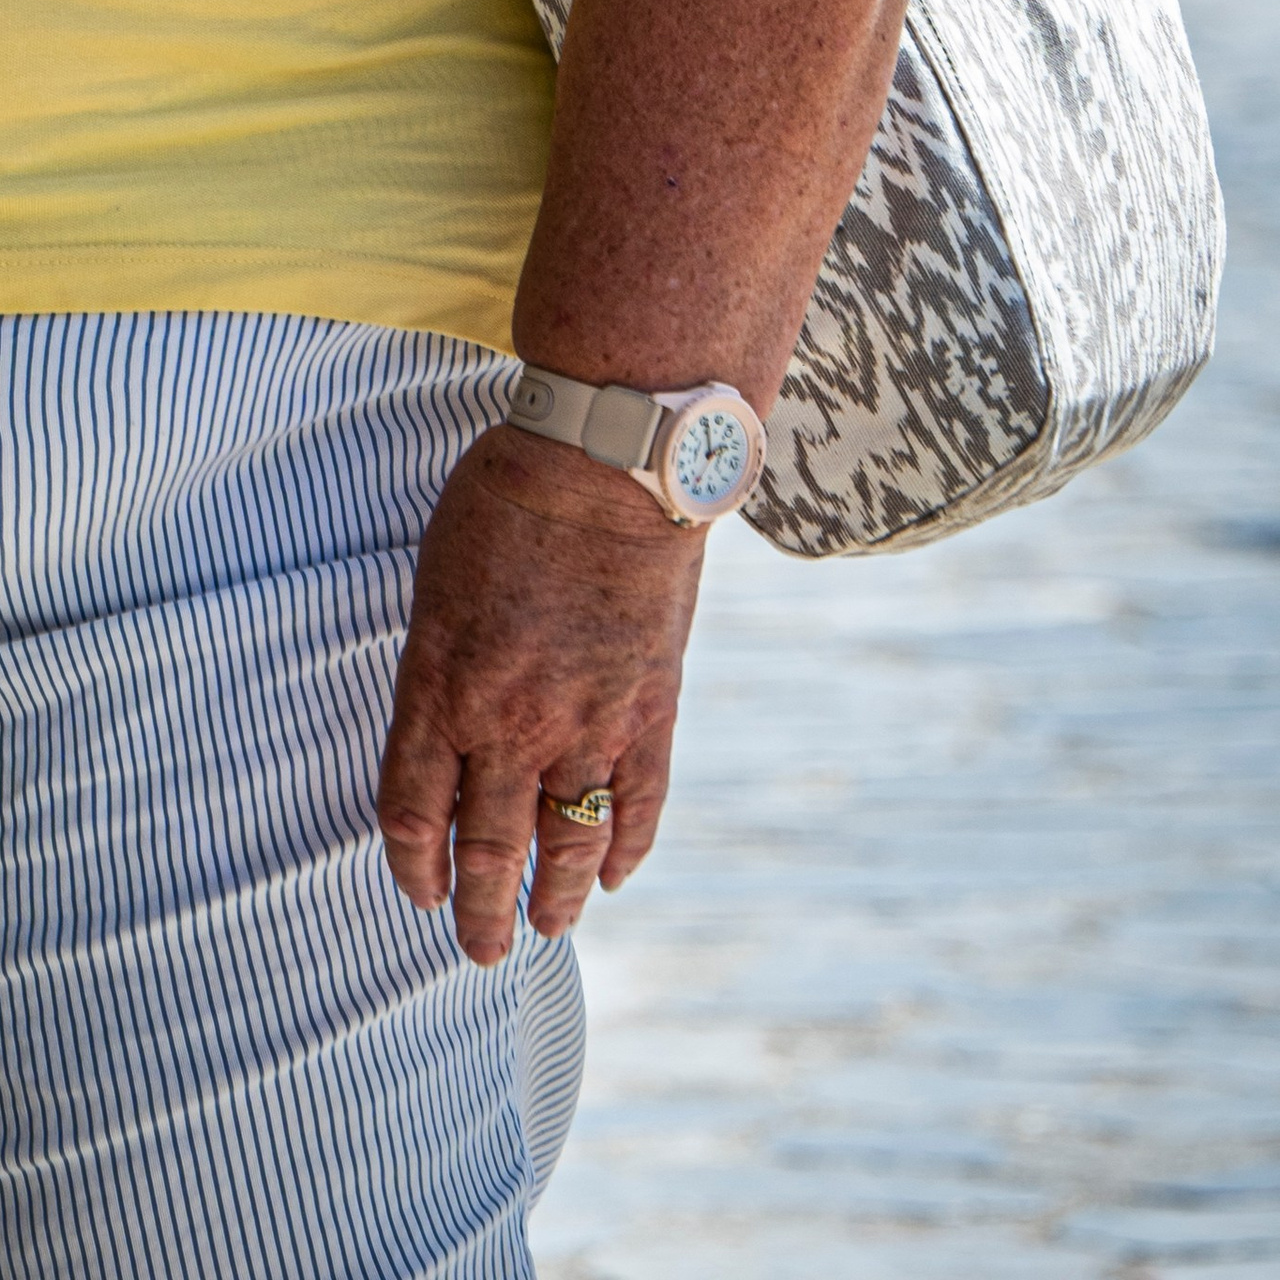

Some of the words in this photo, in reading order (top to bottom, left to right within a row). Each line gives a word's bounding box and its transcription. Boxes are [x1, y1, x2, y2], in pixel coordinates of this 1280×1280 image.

[724, 425, 734, 438] 10
[731, 440, 740, 450] 11
[730, 456, 739, 470] 12
[707, 483, 716, 495] 2
